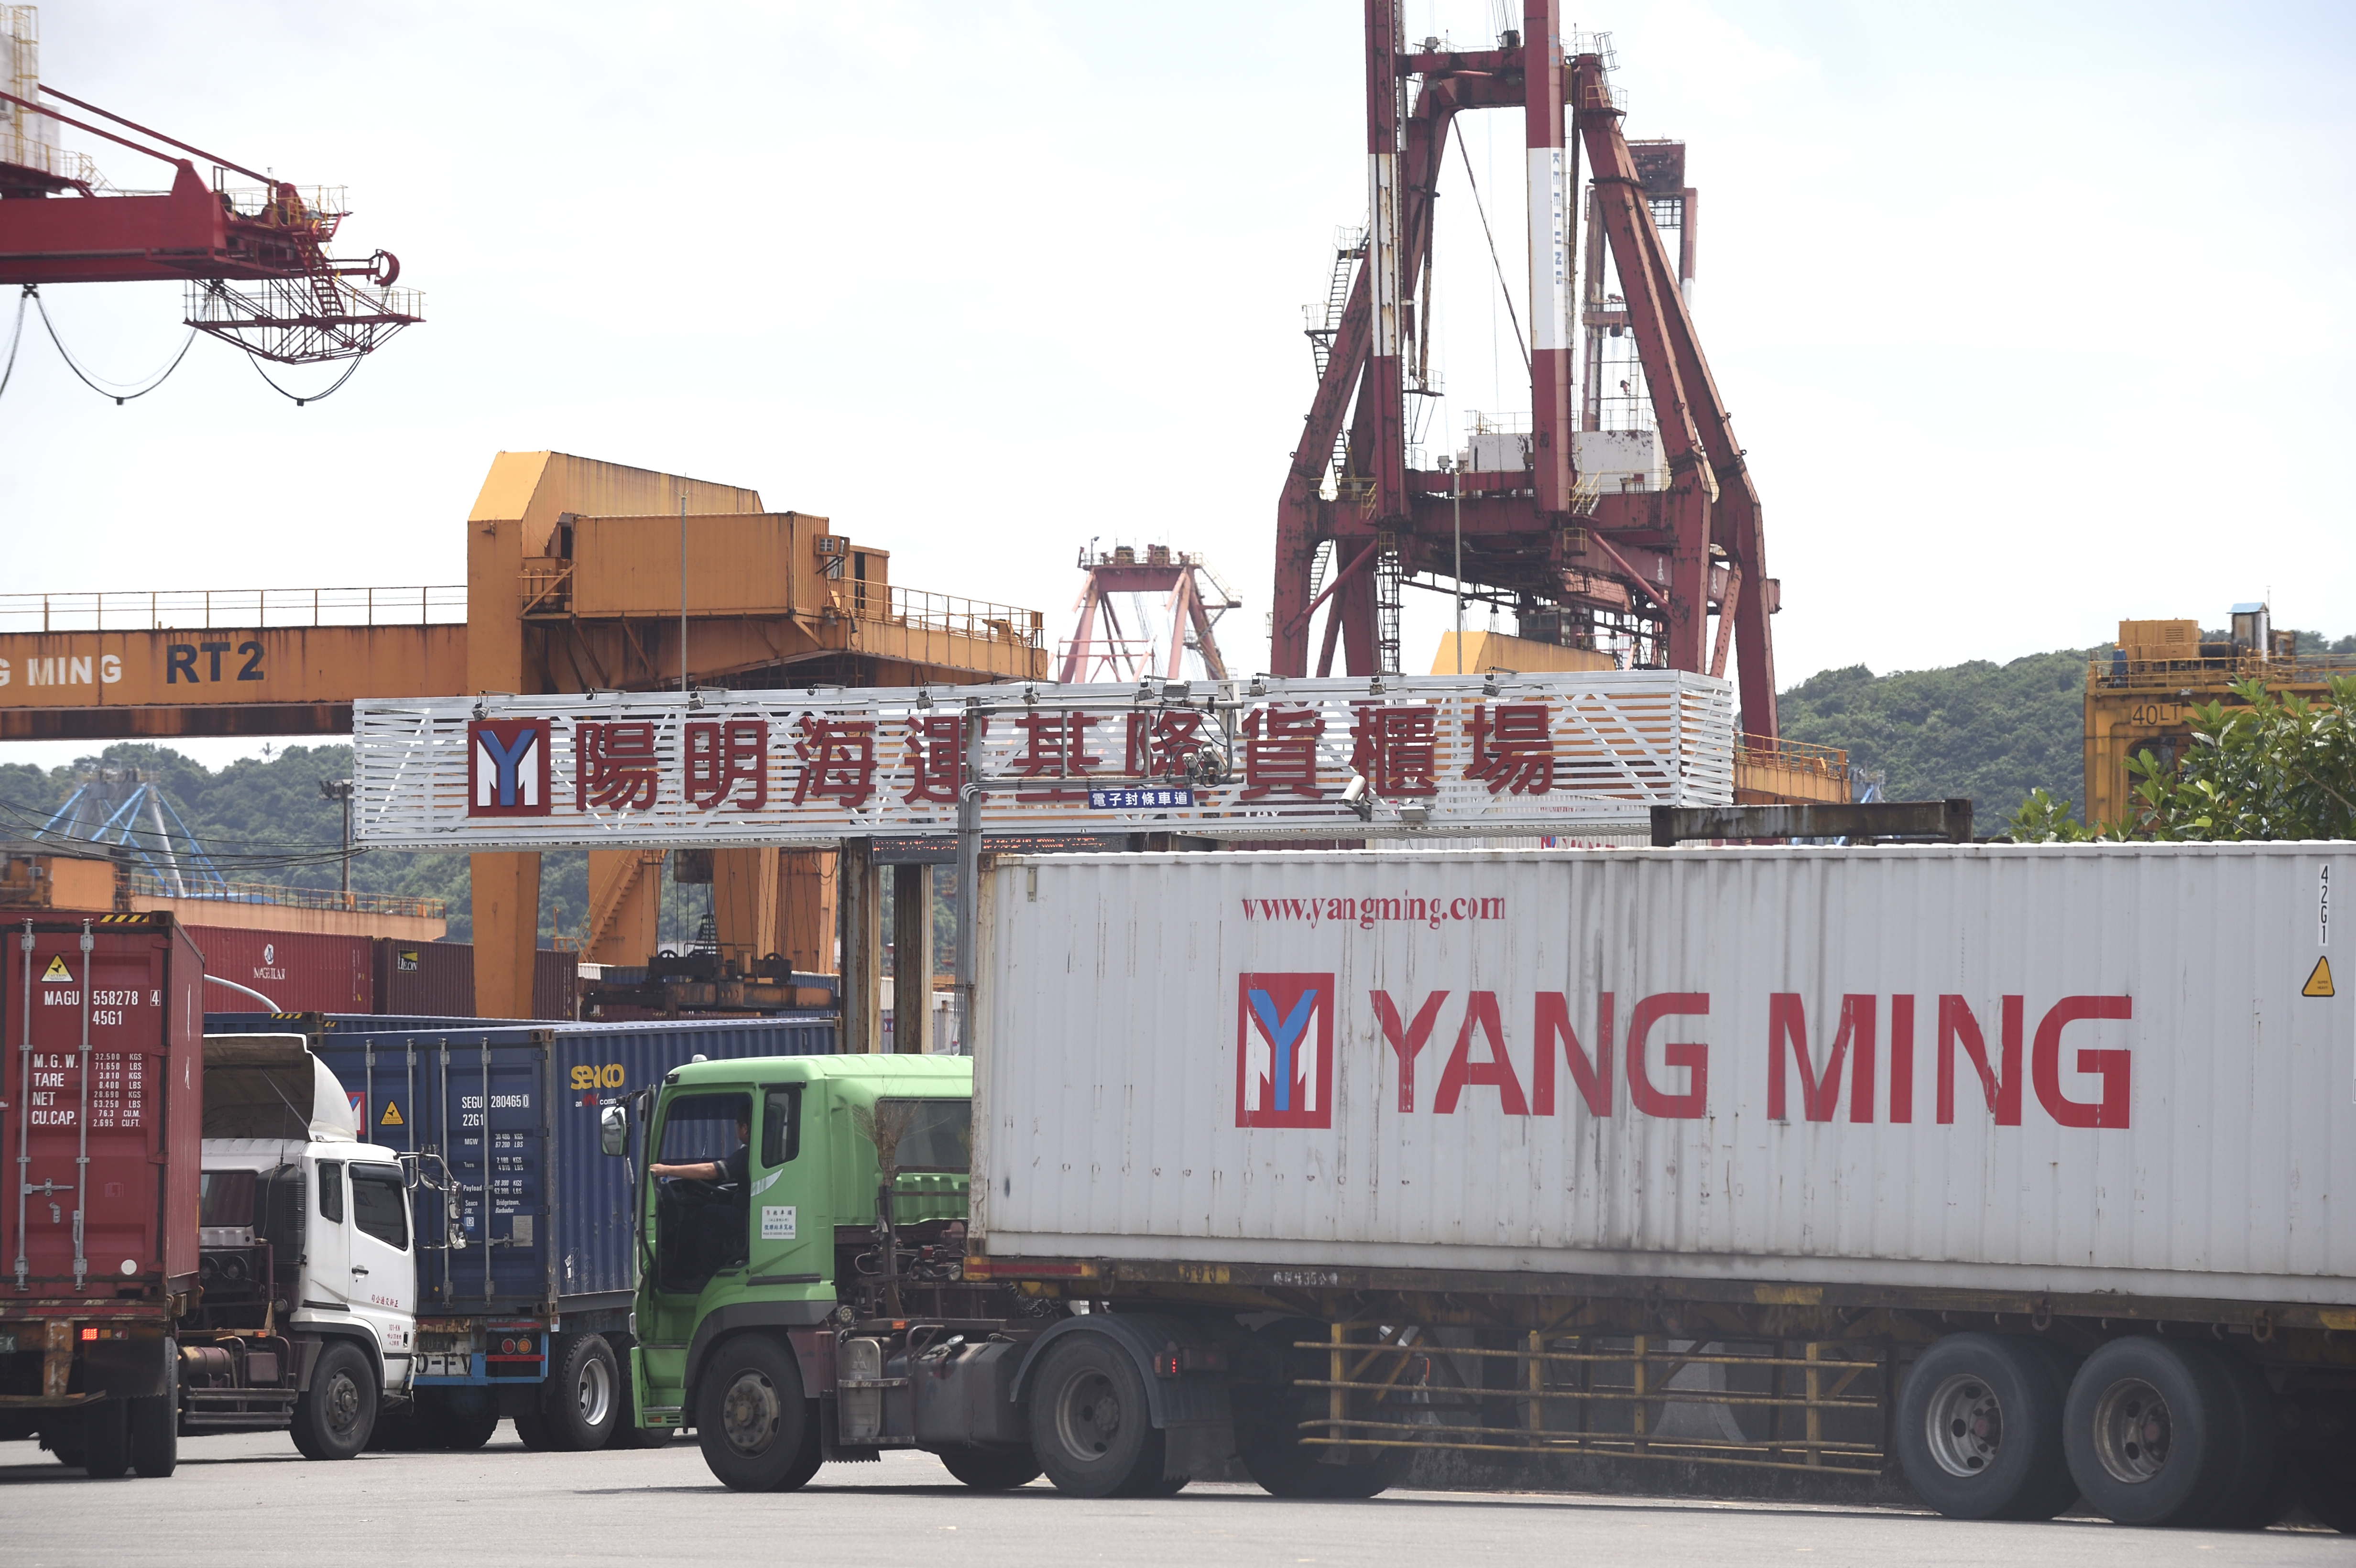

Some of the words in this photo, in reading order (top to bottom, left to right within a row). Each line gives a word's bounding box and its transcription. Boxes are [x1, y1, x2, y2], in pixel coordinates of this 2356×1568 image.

[166, 641, 265, 684] RT2
[27, 654, 122, 686] MING
[2132, 704, 2181, 725] 40LT
[1092, 791, 1188, 806] 電子封條車道
[1241, 889, 1506, 930] www.yangming.com
[44, 991, 80, 1005] MAGU
[93, 991, 139, 1005] 558278
[152, 991, 160, 1005] 4
[93, 1011, 122, 1025] 45G1
[95, 1062, 120, 1070] 71.650
[130, 1062, 142, 1070] LBS
[1368, 990, 1710, 1119] YANG
[1767, 991, 2133, 1130] MING
[34, 1073, 65, 1087] TARE
[33, 1091, 56, 1106] NET
[129, 1100, 141, 1108] LBS
[462, 1096, 483, 1109] SEGU
[491, 1095, 521, 1108] 280465
[523, 1095, 529, 1107] 0
[32, 1111, 77, 1125] CU.CAP.
[93, 1119, 114, 1127] 2.695
[121, 1119, 140, 1127] CU.FT.
[463, 1114, 483, 1126] 22G1
